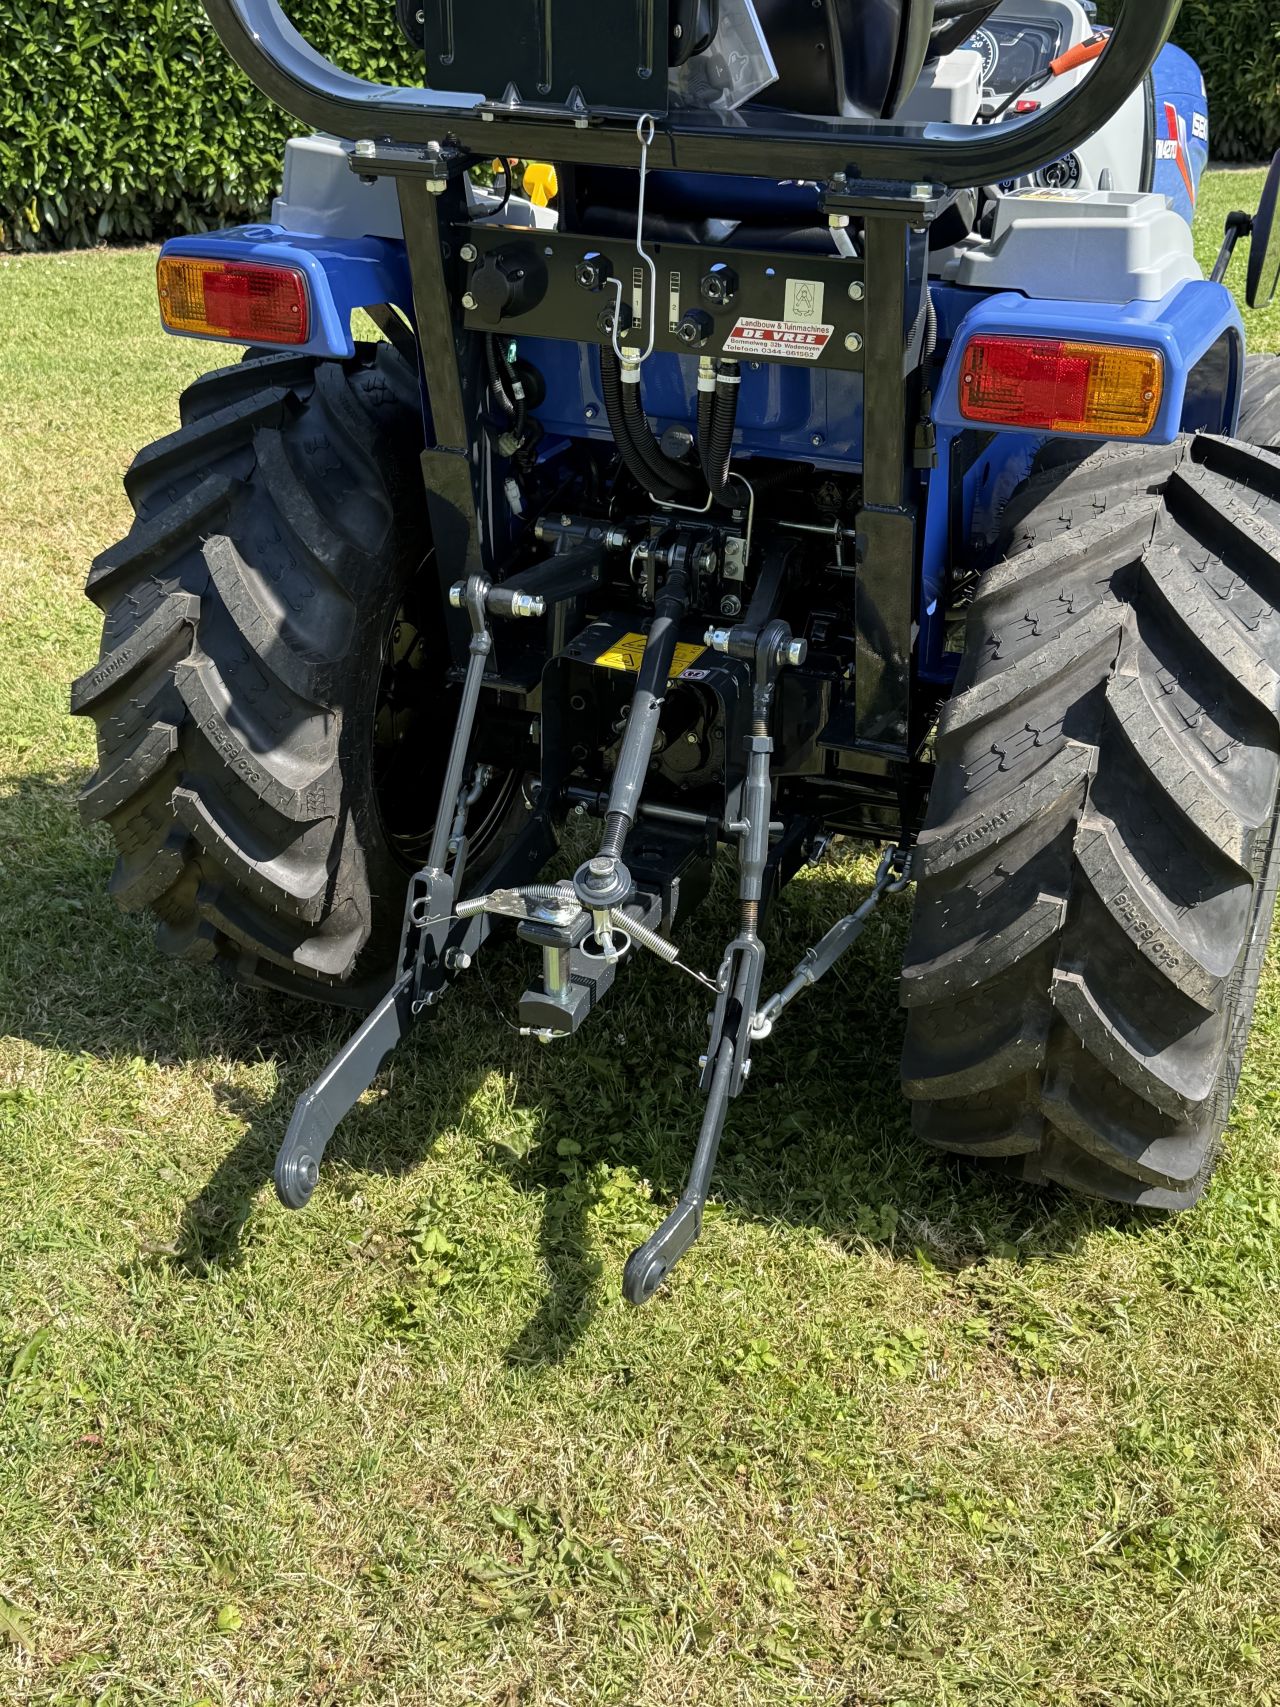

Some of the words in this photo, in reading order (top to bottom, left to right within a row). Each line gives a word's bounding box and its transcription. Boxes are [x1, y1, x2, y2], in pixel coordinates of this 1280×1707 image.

[740, 319, 776, 329] Landbouw
[784, 323, 830, 334] Tuinmachines
[730, 338, 768, 347] Bommelweg
[742, 329, 765, 339] DE
[772, 331, 817, 344] VREE
[726, 345, 759, 353] Telefoon
